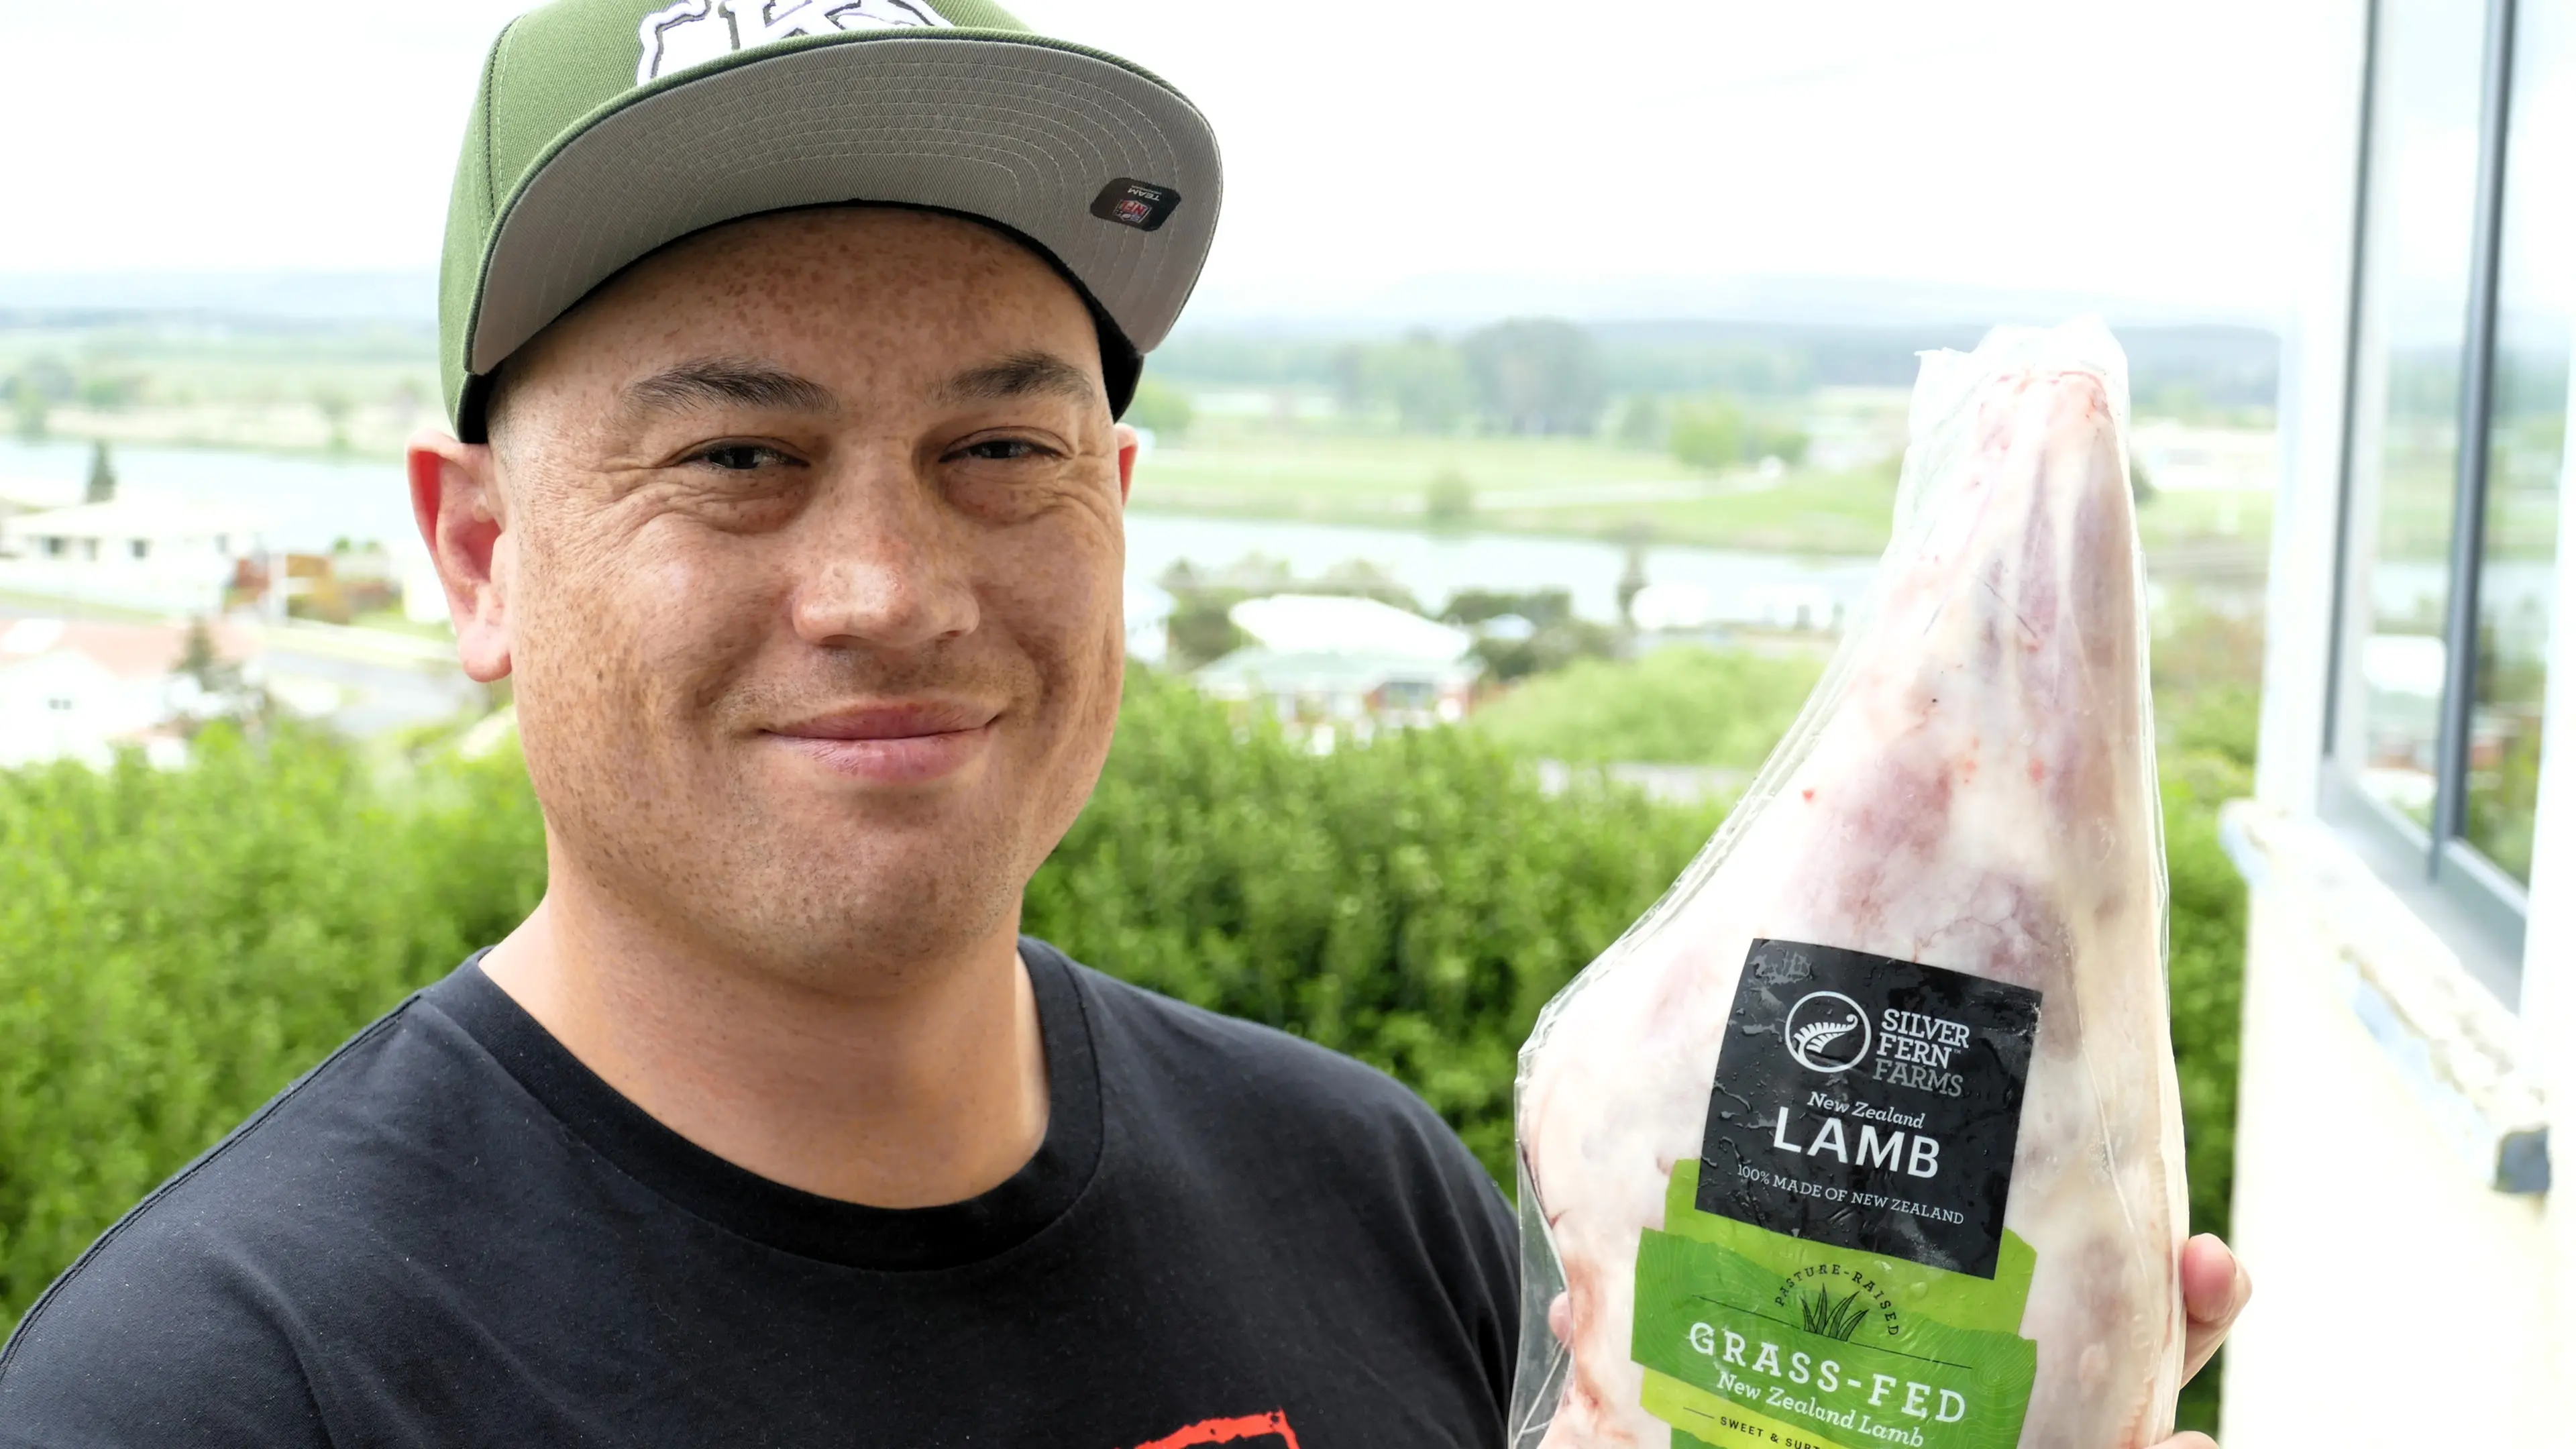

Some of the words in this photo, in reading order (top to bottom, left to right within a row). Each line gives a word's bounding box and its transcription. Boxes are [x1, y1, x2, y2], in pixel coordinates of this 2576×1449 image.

[1127, 187, 1160, 201] TEAM
[1881, 1008, 1970, 1049] SILVER
[1872, 1057, 1964, 1097] FARMS
[1807, 1091, 1850, 1114] New
[1851, 1101, 1926, 1128] Zealand
[1773, 1106, 1941, 1179] LAMB
[1737, 1164, 1770, 1185] 100%
[1772, 1174, 1823, 1198] MADE
[1824, 1187, 1847, 1203] OF
[1851, 1192, 1888, 1208] NEW
[1890, 1198, 1965, 1225] ZEALAND
[1774, 1263, 1900, 1336] PASTURE-RAISED
[1689, 1322, 1967, 1424] GRASS-FED
[1717, 1371, 1761, 1400] New
[1764, 1387, 1855, 1430] Zealand
[1857, 1415, 1925, 1449] Lamb
[1720, 1416, 1764, 1438] SWEET
[1770, 1432, 1779, 1444] &
